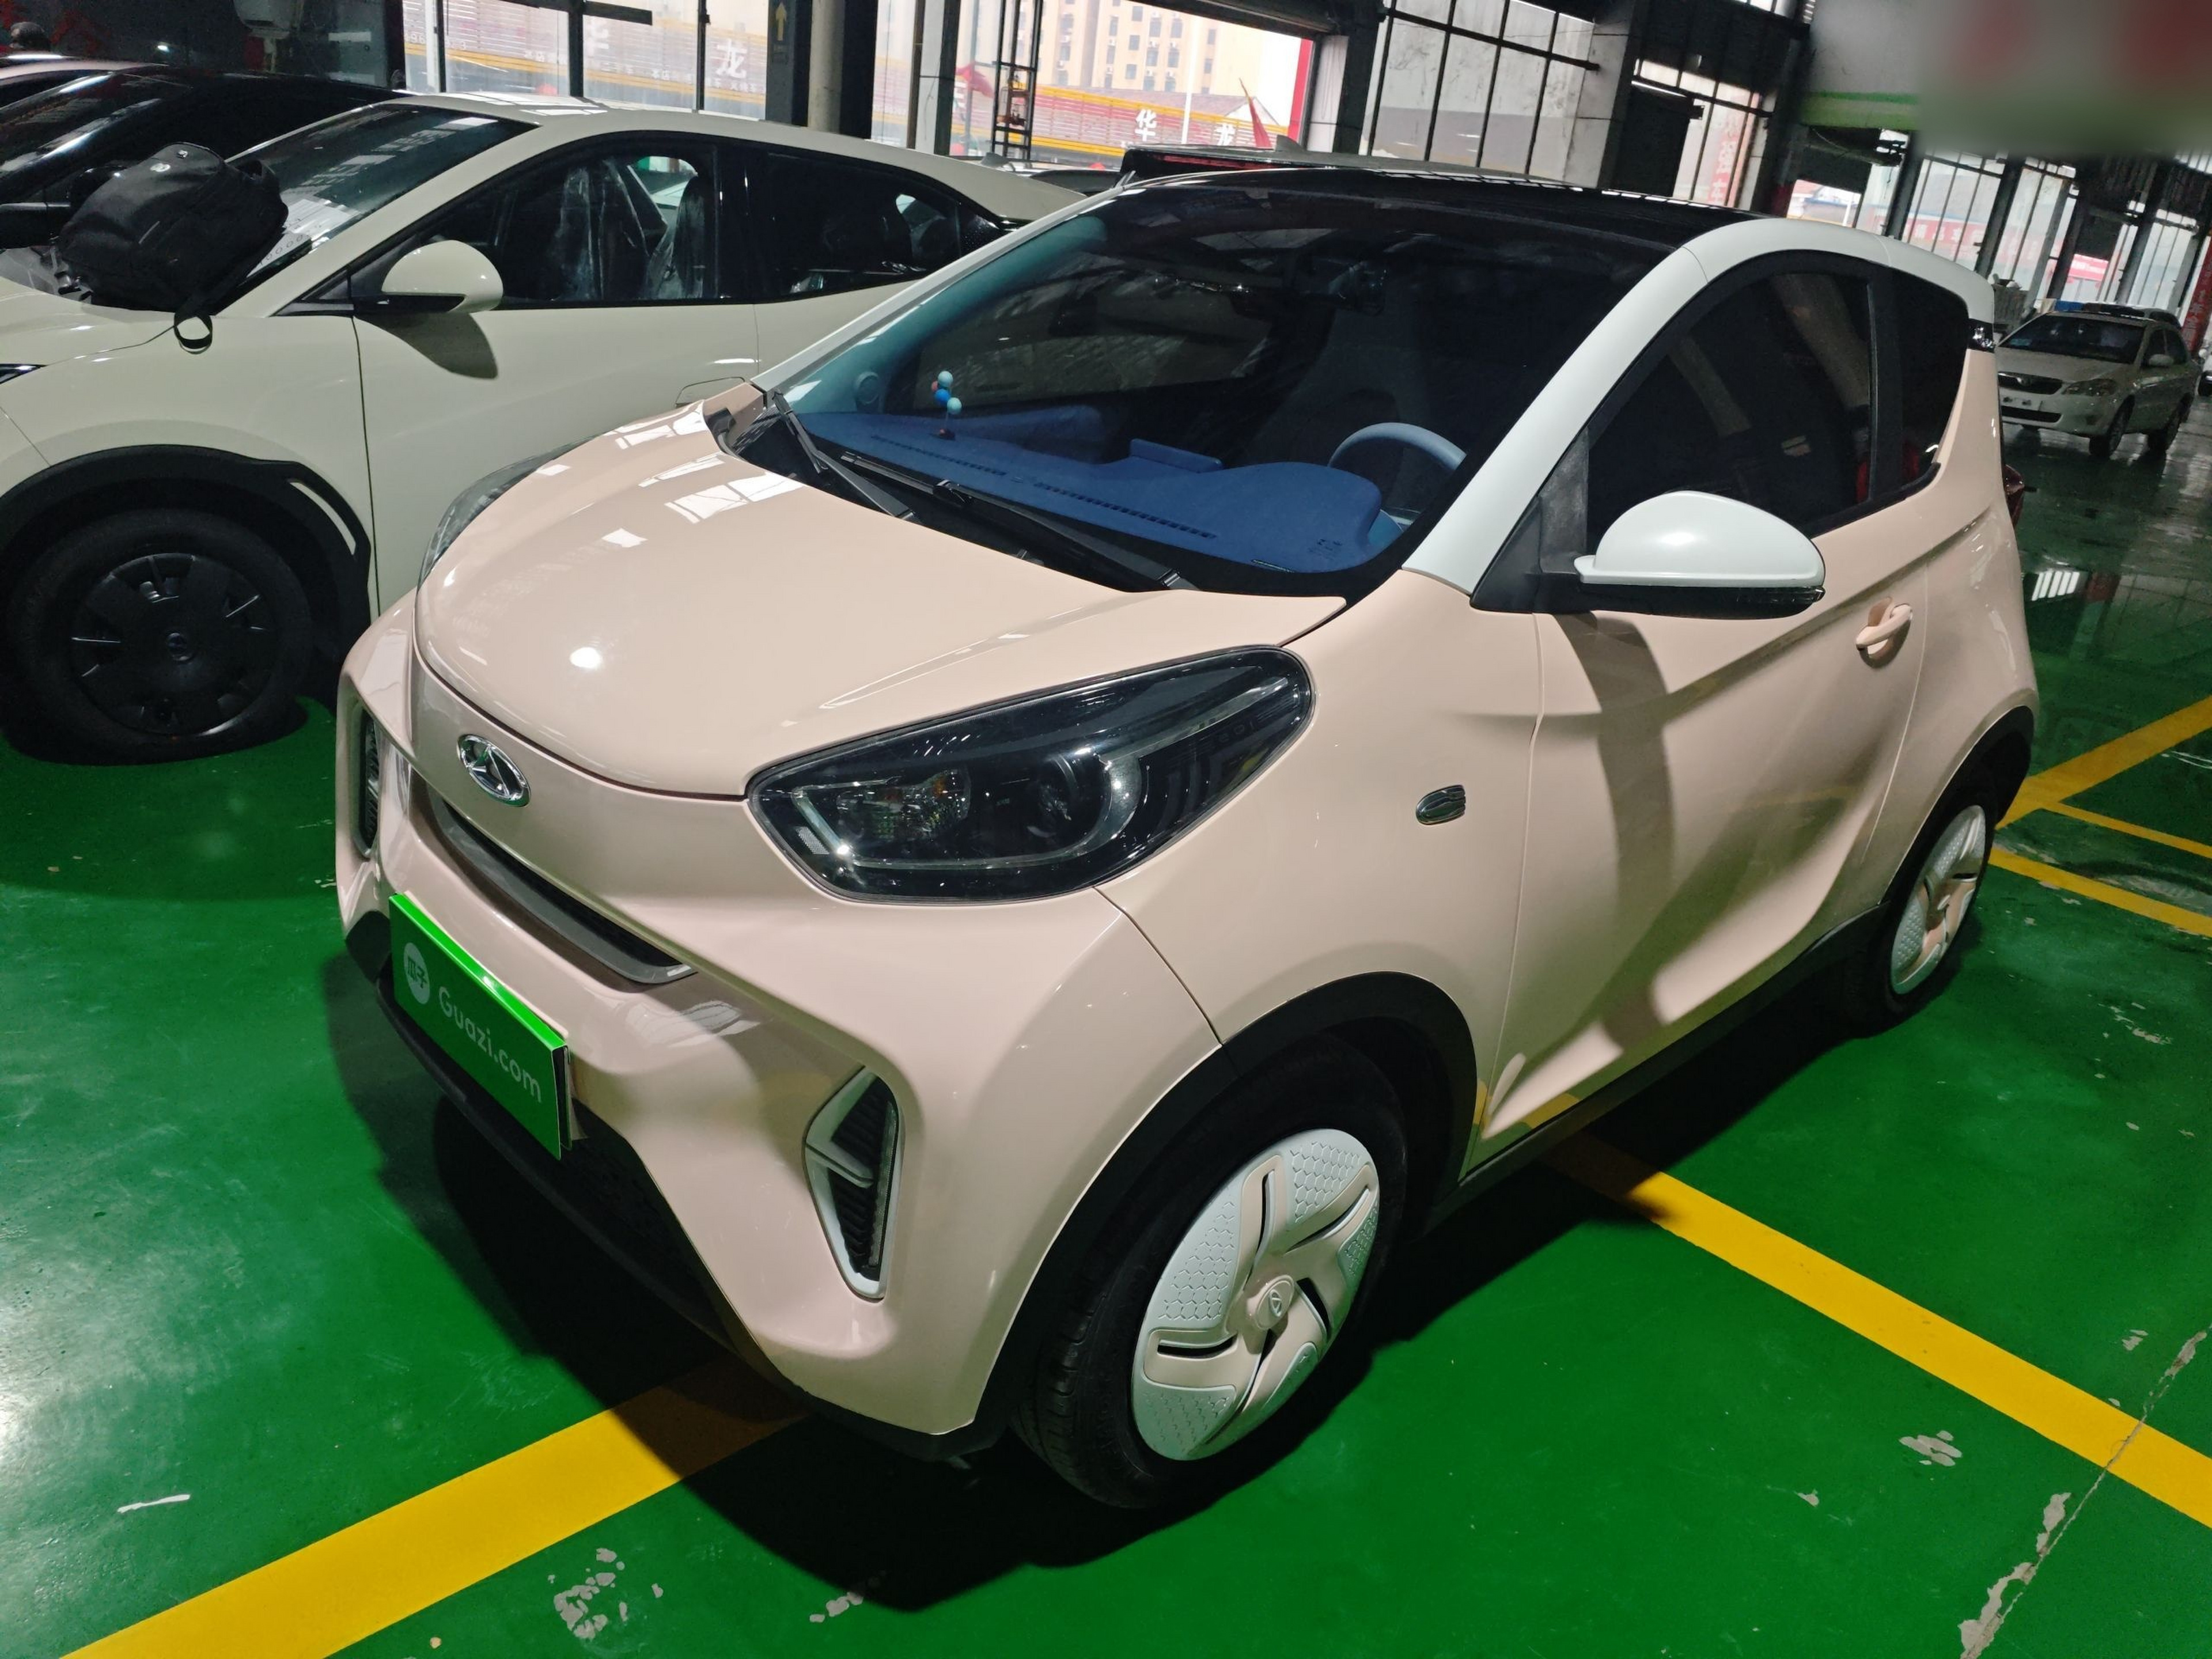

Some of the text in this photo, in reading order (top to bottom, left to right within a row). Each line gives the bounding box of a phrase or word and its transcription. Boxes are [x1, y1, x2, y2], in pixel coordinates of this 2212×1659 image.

[715, 38, 747, 79] 龙
[1134, 108, 1157, 142] 华
[407, 956, 427, 989] 瓜子
[438, 986, 541, 1103] Guazi.com
